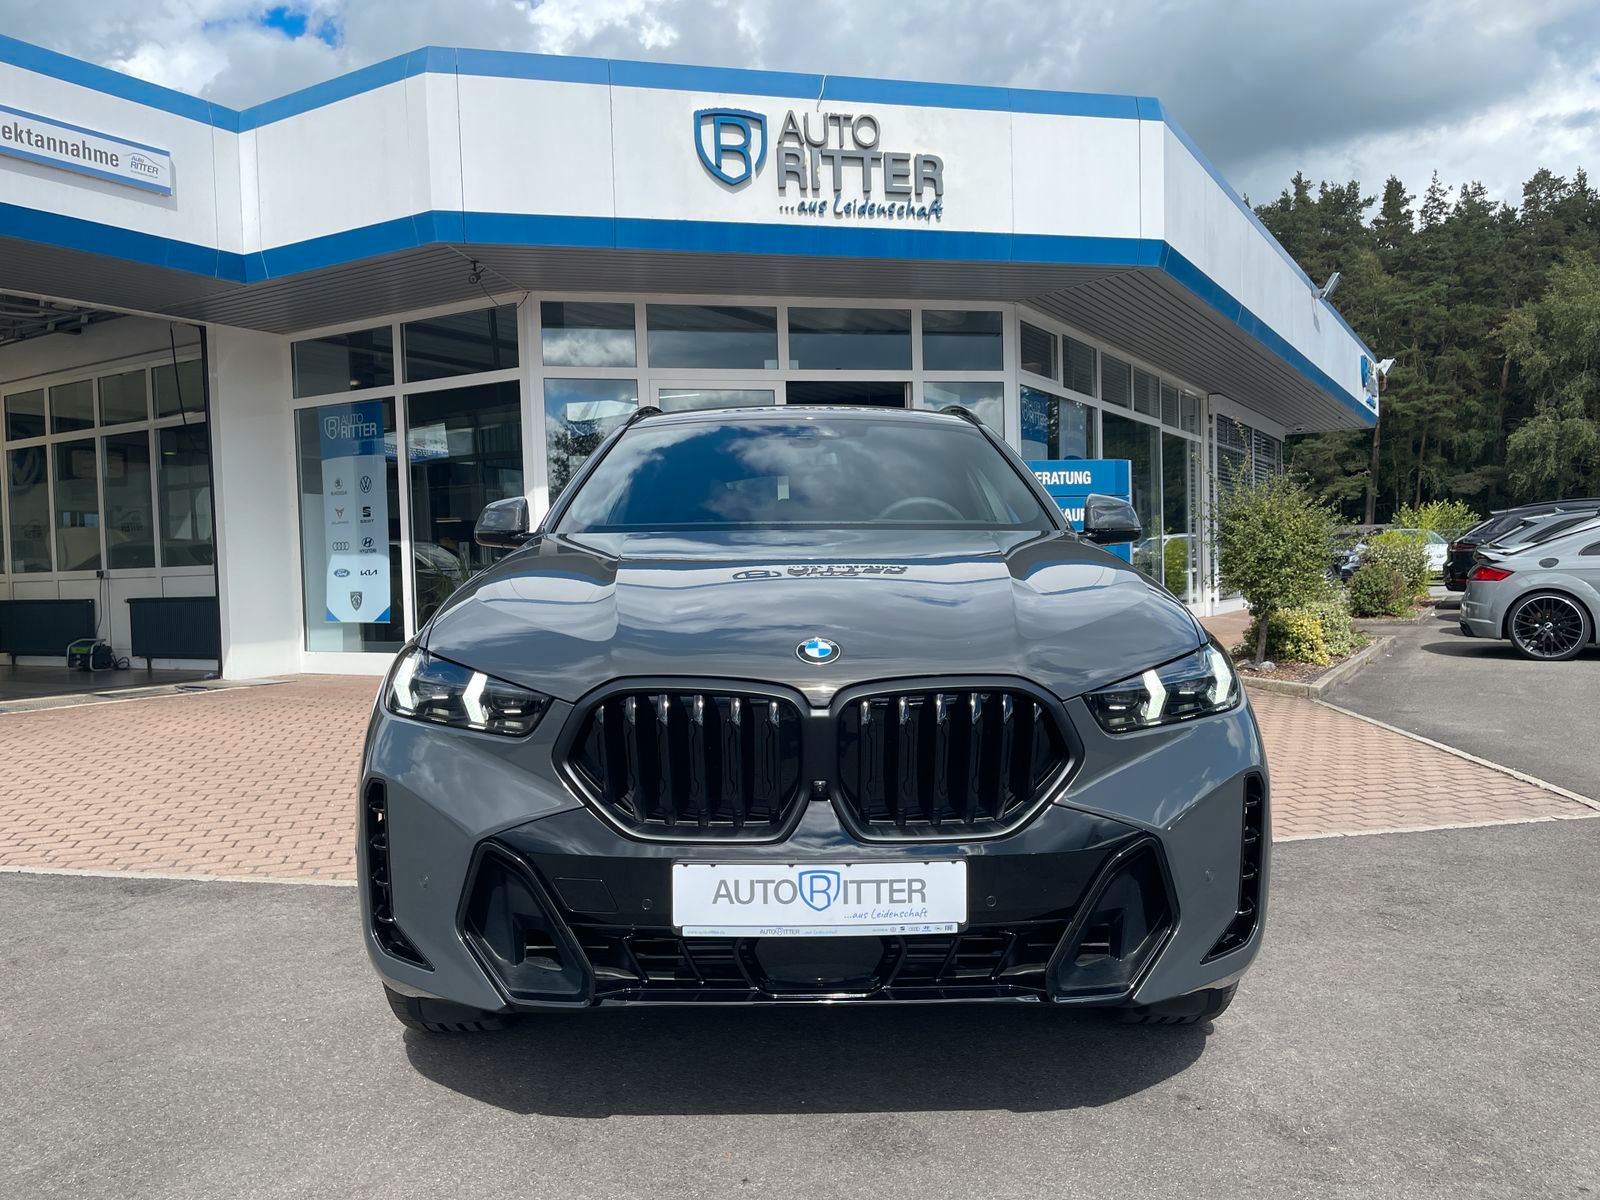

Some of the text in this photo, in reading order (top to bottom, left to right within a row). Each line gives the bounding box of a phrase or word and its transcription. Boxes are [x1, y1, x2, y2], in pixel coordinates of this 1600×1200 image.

[777, 110, 880, 148] AUTO
[130, 161, 159, 175] RITTER
[777, 147, 944, 196] RITTER
[833, 192, 943, 223] Leidenschaft
[341, 413, 364, 425] AUTO
[340, 422, 377, 439] RITTER
[871, 907, 928, 919] Leidenschaft
